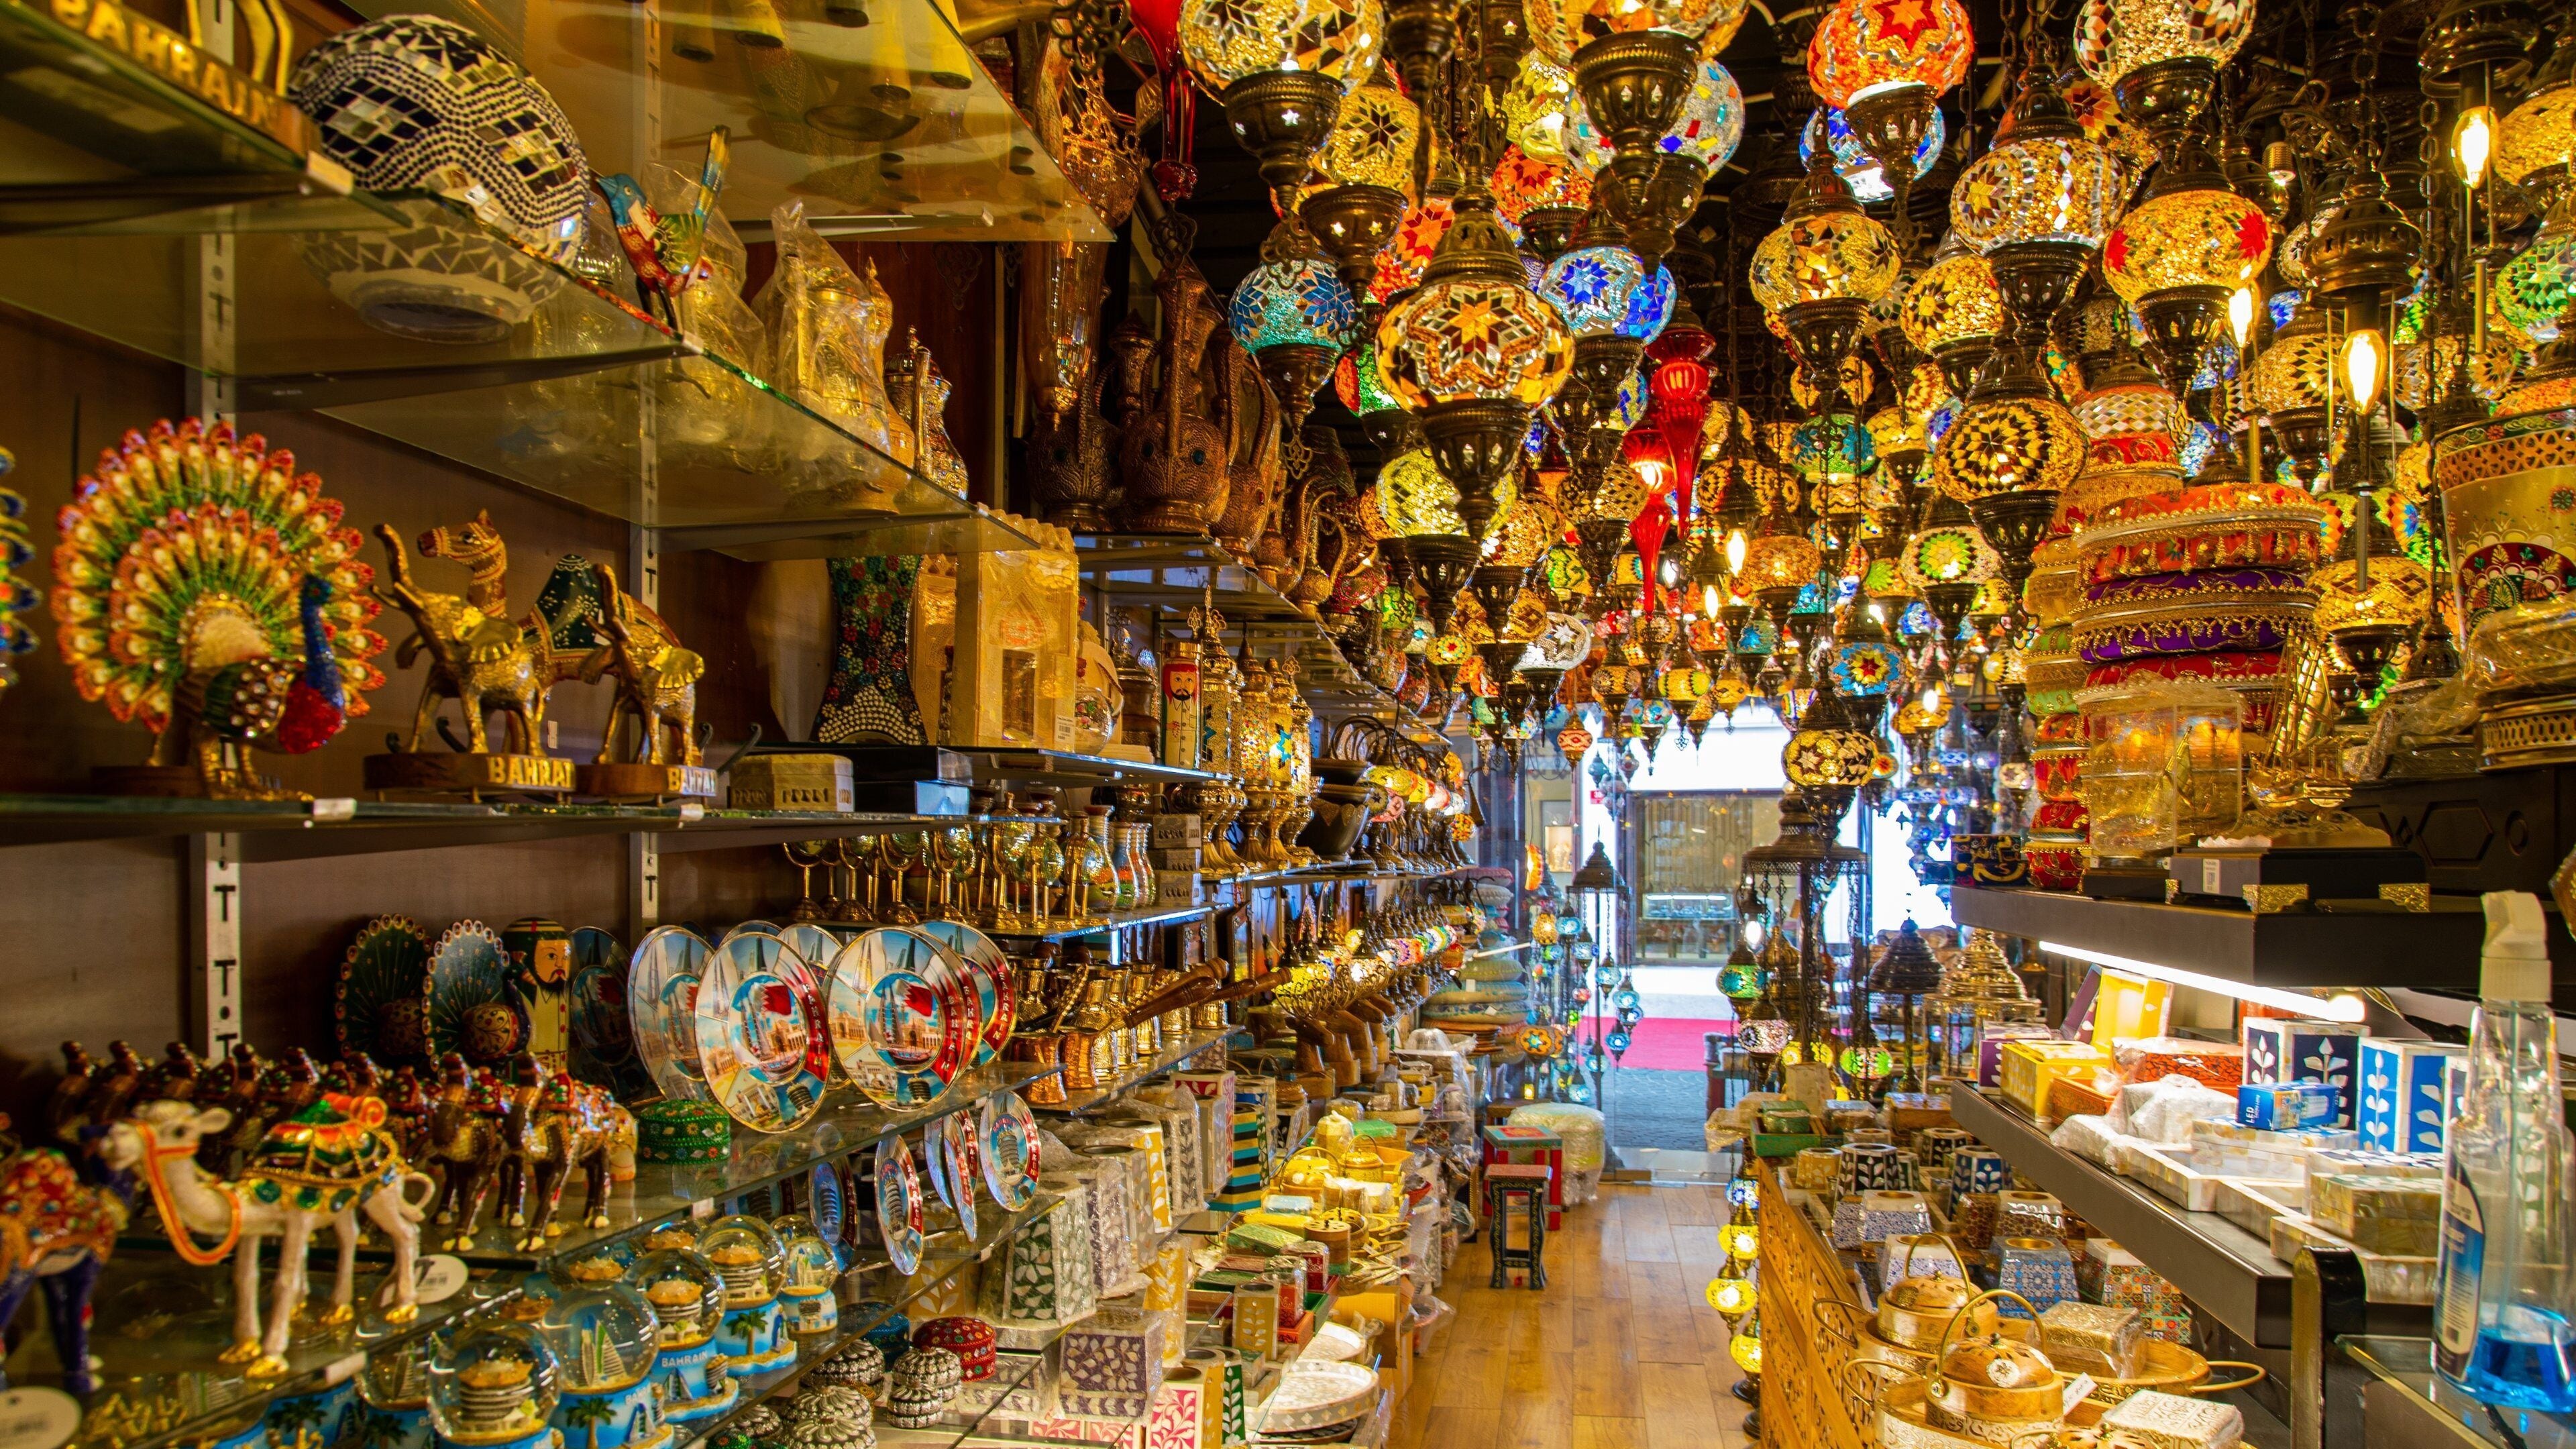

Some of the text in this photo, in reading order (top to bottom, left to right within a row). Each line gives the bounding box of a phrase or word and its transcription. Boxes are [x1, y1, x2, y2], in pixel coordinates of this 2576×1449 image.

[51, 0, 278, 125] BAHRAIN
[487, 757, 573, 788] BAHRAI
[802, 983, 822, 1067] BAHRAIN
[941, 996, 960, 1072] BAHRAIN
[963, 985, 976, 1040] BAHRA
[992, 971, 1011, 1040] BAHRAIN
[2245, 1106, 2255, 1124] LED
[661, 1350, 708, 1368] BAHRAIN
